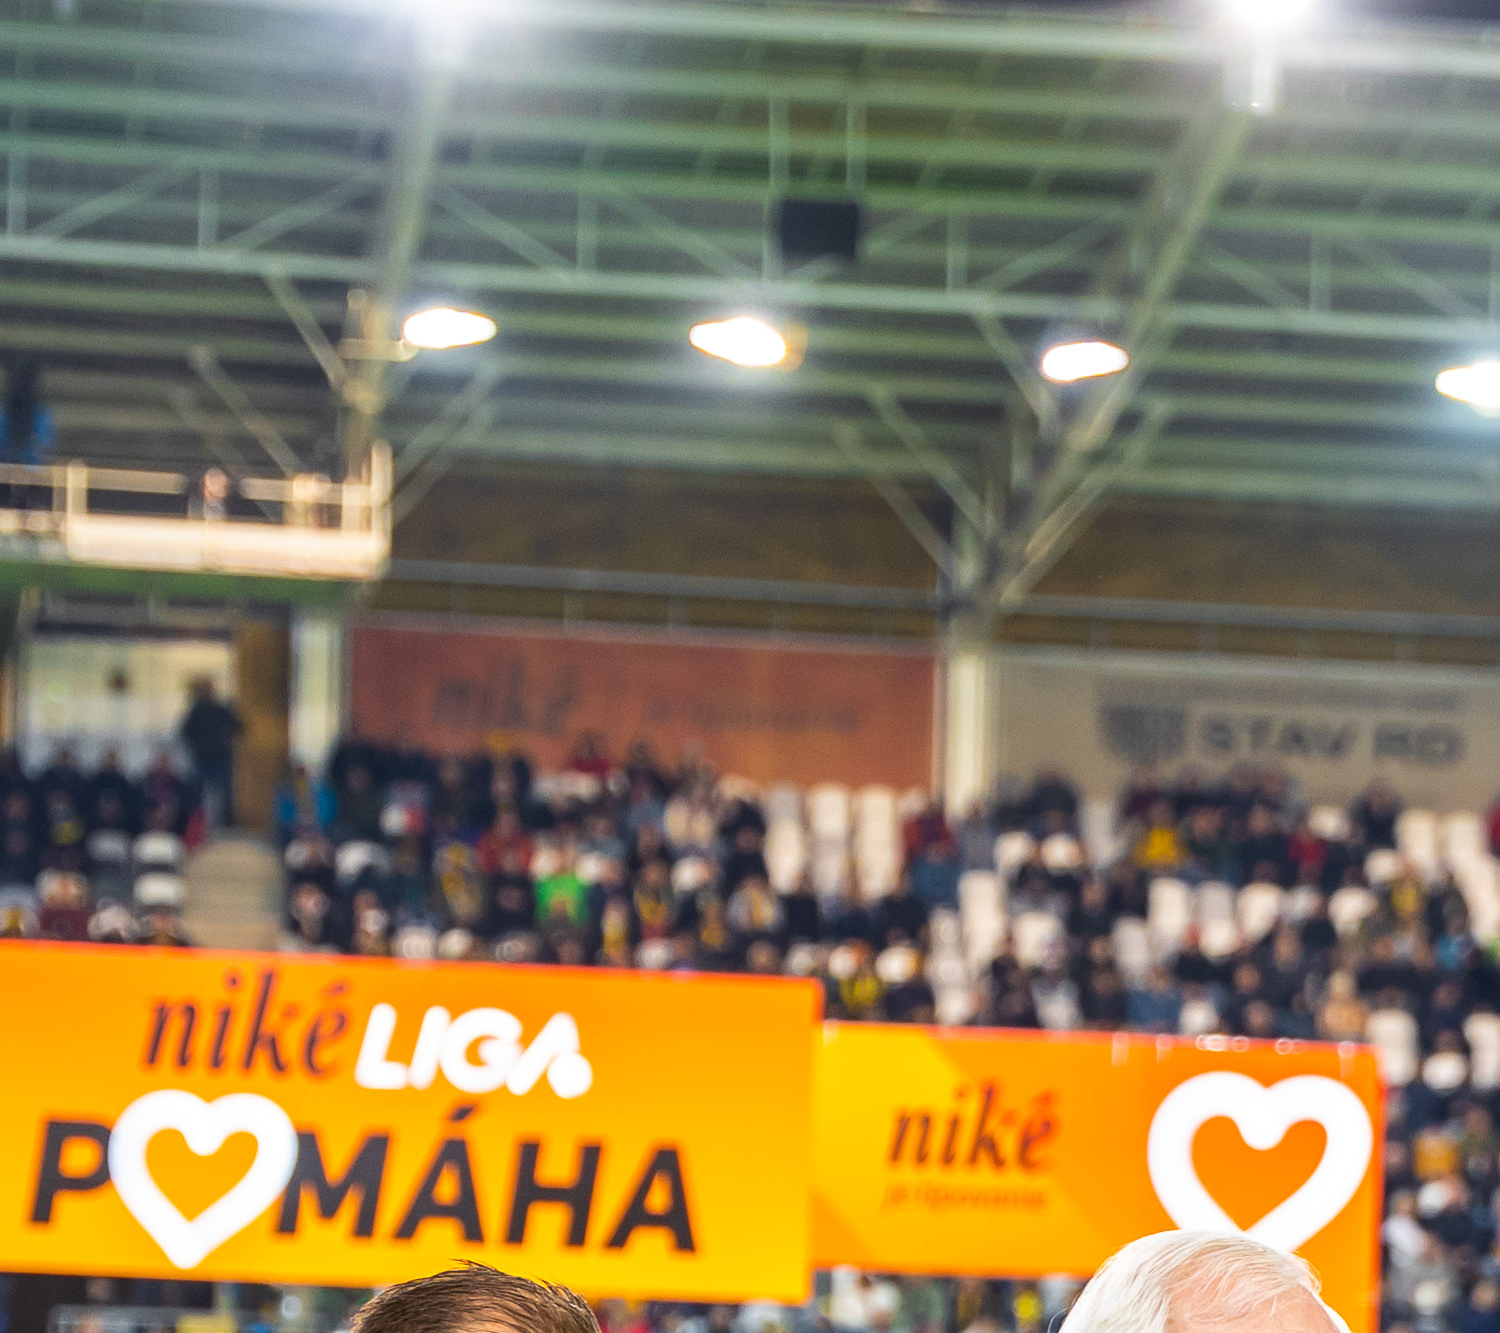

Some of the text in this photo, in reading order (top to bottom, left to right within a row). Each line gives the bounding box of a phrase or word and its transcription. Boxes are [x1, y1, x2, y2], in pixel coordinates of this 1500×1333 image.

[141, 968, 594, 1099] niké LIGA
[884, 1081, 1057, 1170] niké
